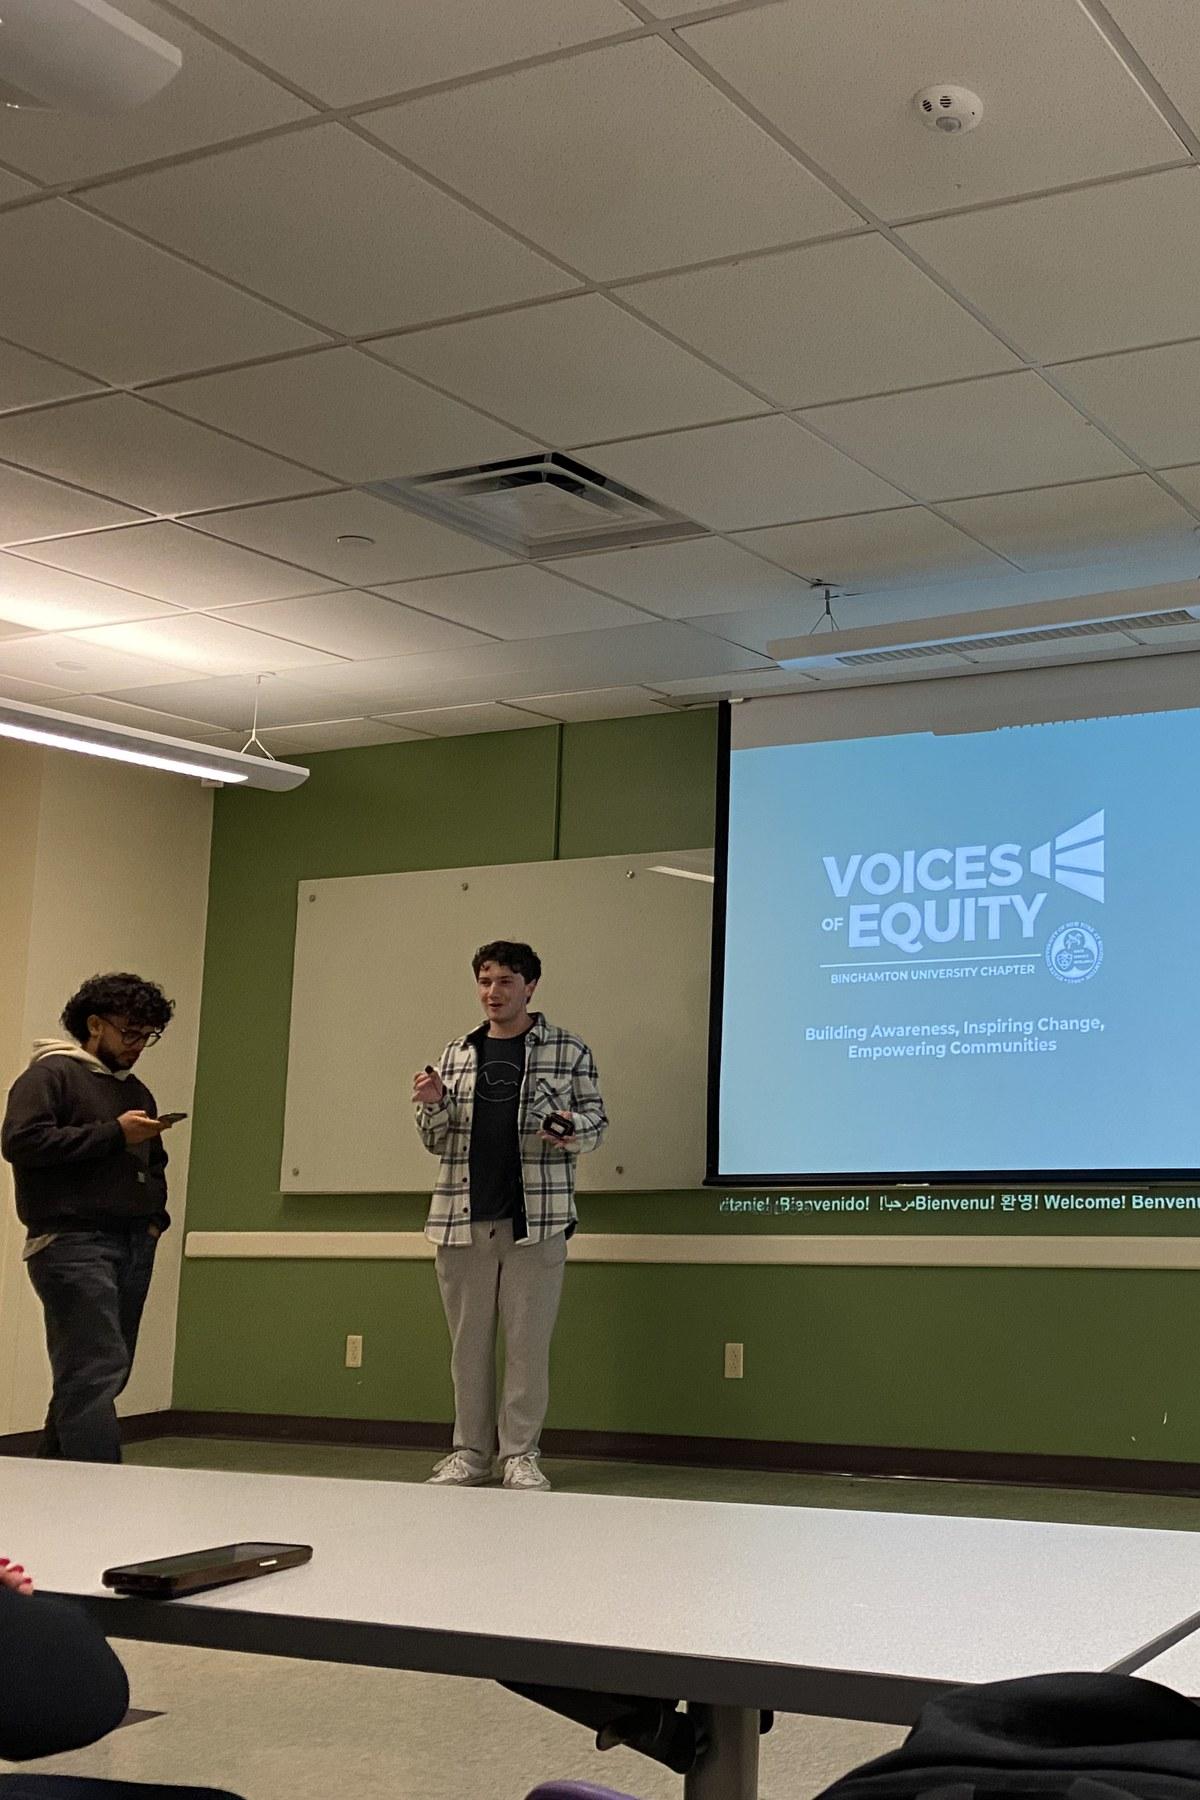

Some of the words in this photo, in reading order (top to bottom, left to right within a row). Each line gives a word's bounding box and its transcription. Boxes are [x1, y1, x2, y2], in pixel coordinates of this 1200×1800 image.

[822, 844, 1023, 897] VOICES
[821, 917, 844, 931] OF
[848, 892, 1048, 953] EQUITY
[830, 970, 908, 984] BINGHAMTON
[910, 967, 979, 980] UNIVERSITY
[980, 964, 1036, 978] CHAPTER
[805, 1025, 868, 1043] Building
[871, 1022, 961, 1039] Awareness,
[963, 1018, 1034, 1036] Inspiring
[1037, 1015, 1106, 1033] Change,
[848, 1042, 947, 1061] Empowering
[949, 1037, 1057, 1055] Communities
[915, 1195, 995, 1211] Bienvenu!
[1044, 1194, 1126, 1210] Welcome!
